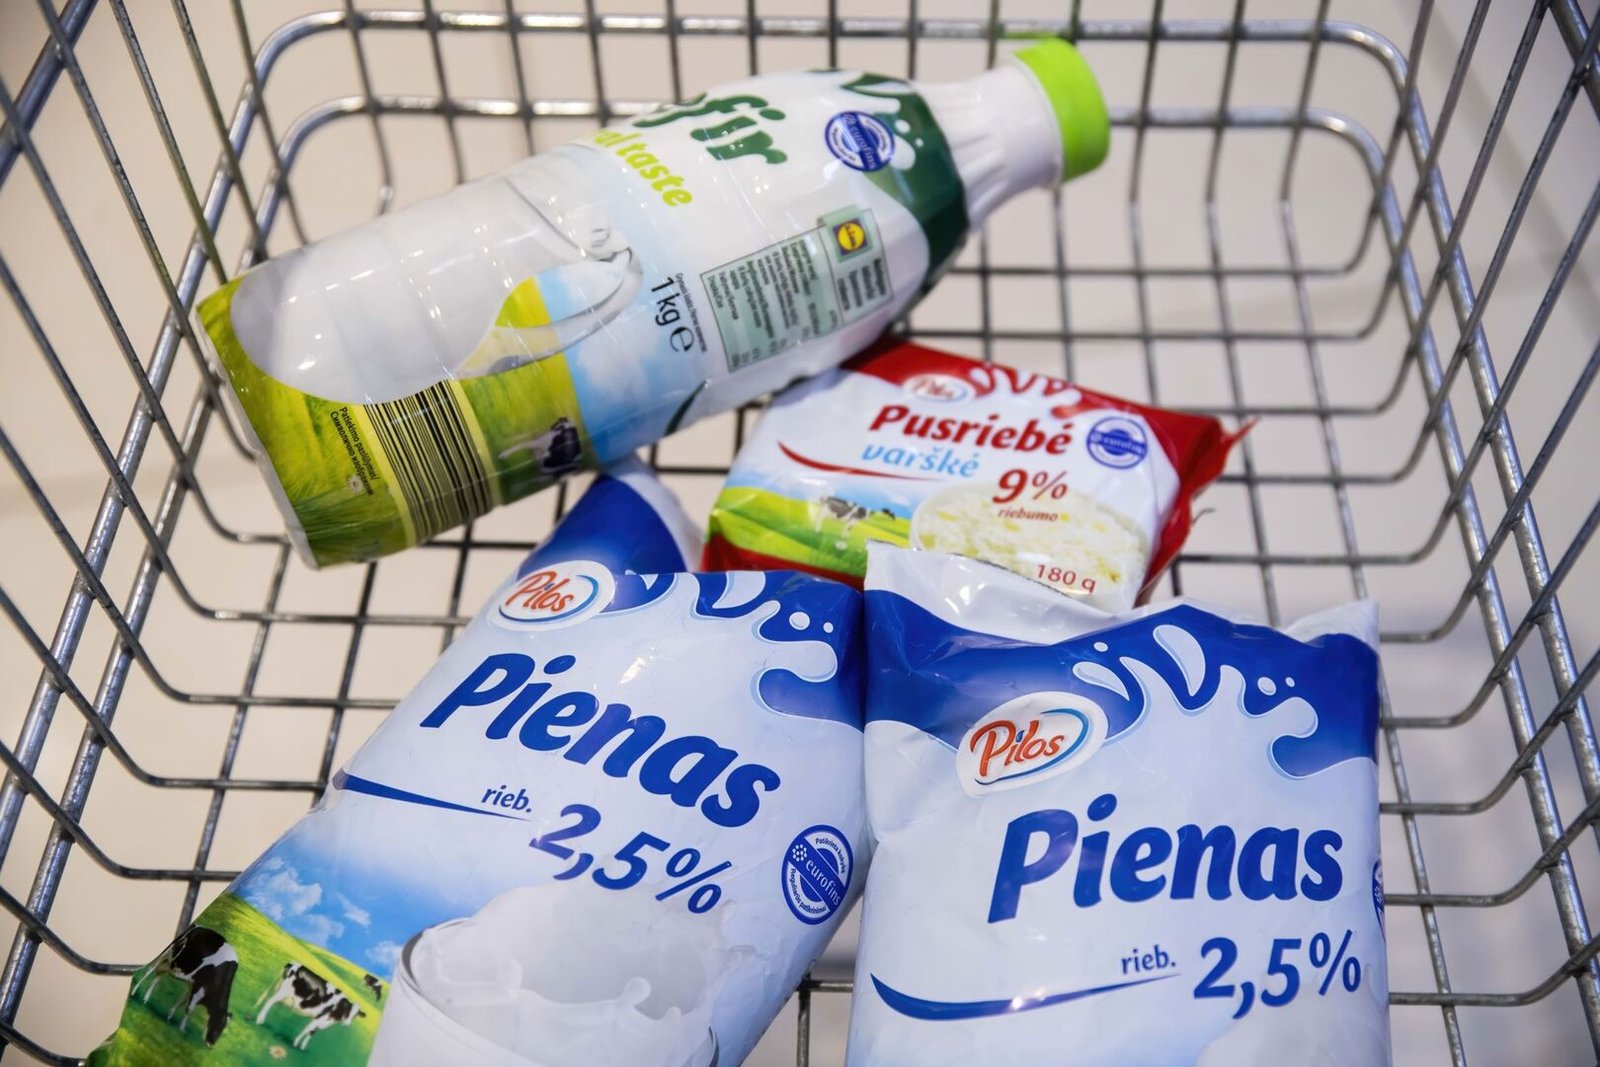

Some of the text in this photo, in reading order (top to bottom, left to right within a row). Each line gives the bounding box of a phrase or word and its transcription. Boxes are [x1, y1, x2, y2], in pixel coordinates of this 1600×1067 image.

[632, 93, 788, 165] fir
[616, 142, 693, 207] taste
[651, 277, 675, 292] 1
[655, 293, 680, 326] kg
[339, 406, 360, 444] Patiekimo
[868, 404, 1076, 456] Pusriebė
[861, 444, 981, 478] varškė
[991, 468, 1069, 504] 9%
[998, 507, 1059, 523] riebumo
[505, 570, 575, 614] Pilos
[1036, 563, 1077, 587] 180
[419, 652, 781, 828] Pienas
[969, 719, 1065, 778] Pilos
[481, 784, 533, 813] rieb.
[528, 803, 733, 914] 2,5%
[986, 792, 1344, 924] Pienas
[805, 859, 841, 906] eurofins
[1120, 944, 1177, 976] rieb.
[1193, 929, 1362, 1020] 2,5%
